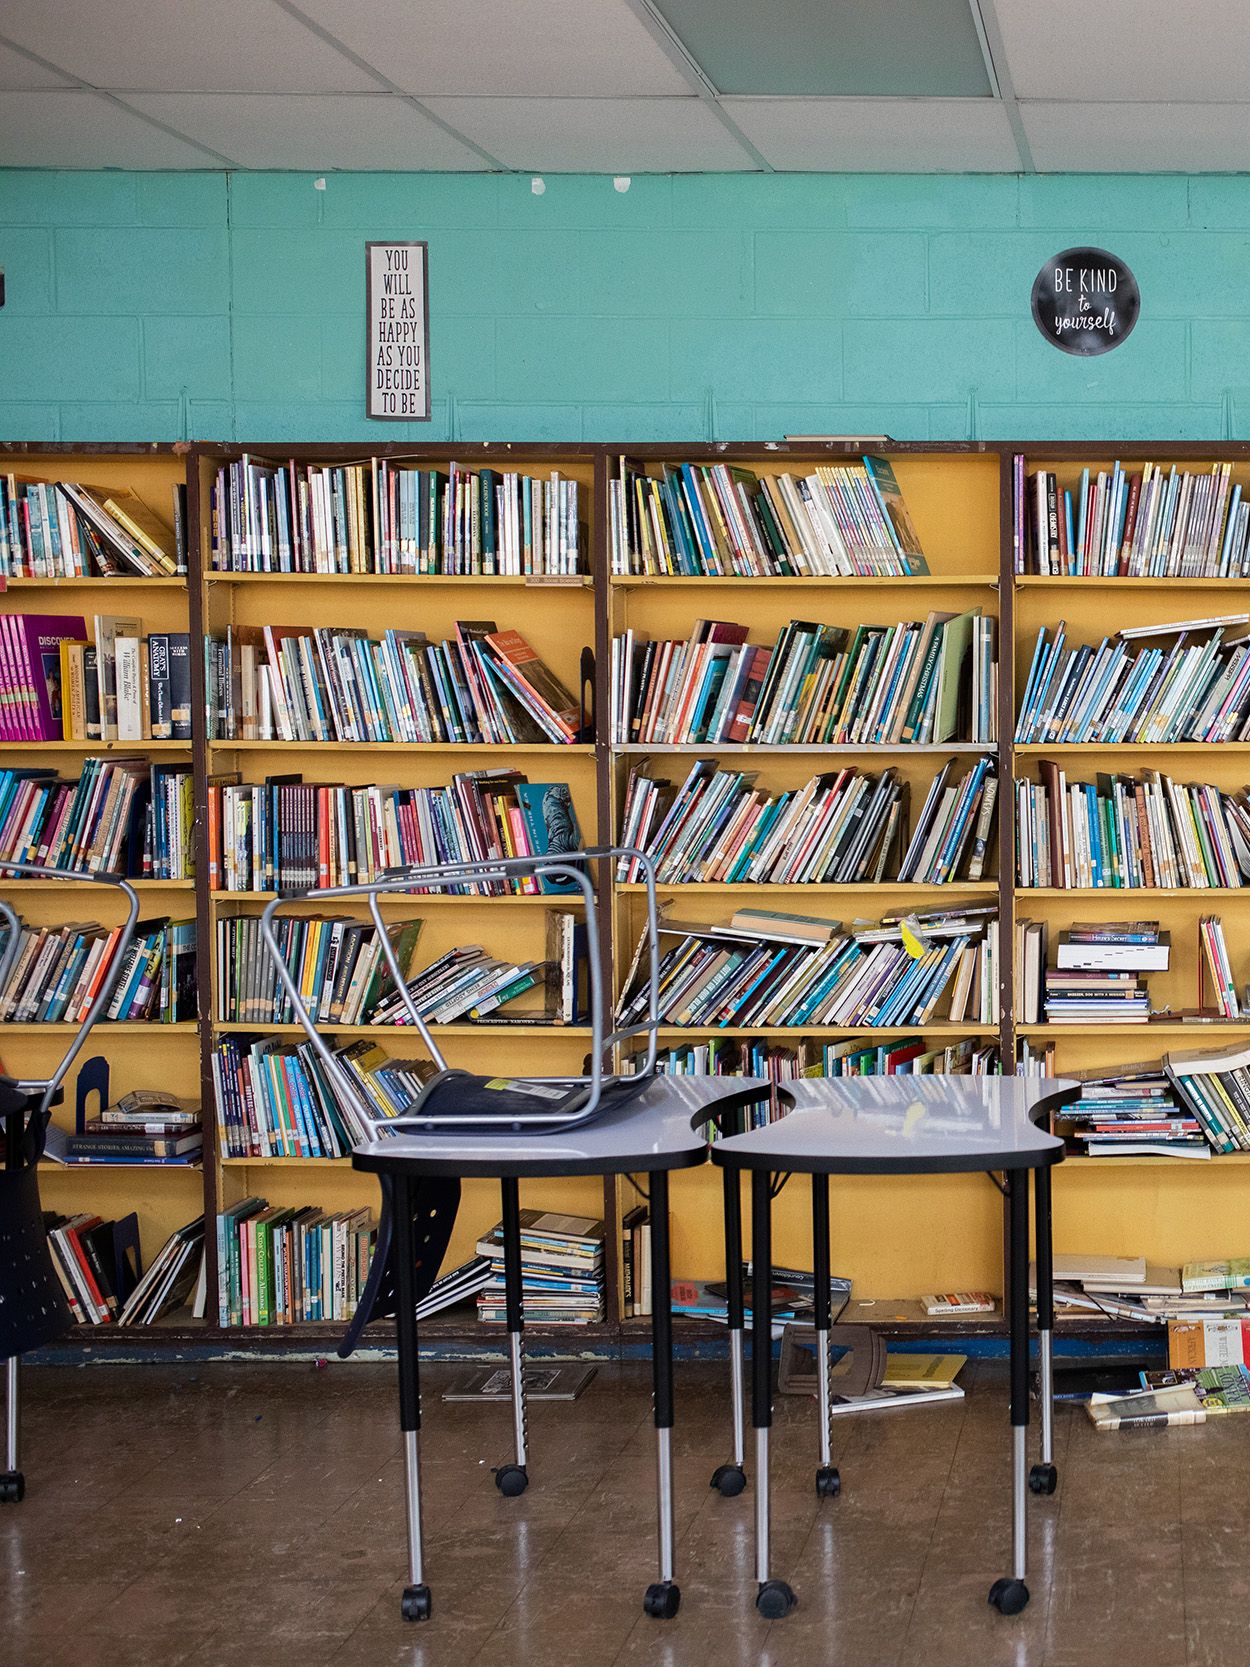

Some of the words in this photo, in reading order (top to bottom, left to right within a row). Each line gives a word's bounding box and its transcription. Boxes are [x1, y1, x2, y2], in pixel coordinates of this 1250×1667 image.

[385, 250, 408, 271] YOU
[383, 274, 412, 295] WILL
[1055, 268, 1073, 292] BE
[1080, 268, 1117, 292] KIND
[381, 298, 395, 319] BE
[401, 298, 416, 319] AS
[1078, 294, 1091, 312] to
[1055, 307, 1116, 335] yourself
[379, 322, 418, 342] HAPPY
[377, 346, 392, 366] AS
[398, 346, 420, 366] YOU
[376, 369, 420, 390] DECIDE
[382, 392, 396, 413] TO
[401, 393, 415, 413] BE
[926, 641, 939, 664] FAMILY
[122, 652, 131, 680] William
[916, 662, 932, 698] CHRISTMAS
[123, 681, 131, 701] Blake
[1140, 815, 1148, 841] Evolution
[1143, 852, 1151, 870] Insects
[133, 938, 142, 948] THE
[343, 933, 357, 963] ADOPTION
[123, 948, 138, 973] WELFARE
[117, 971, 130, 989] STATE
[444, 992, 465, 1008] ADOPTED
[623, 1263, 632, 1297] MATHEMATICS
[1218, 1370, 1241, 1404] RANDY
